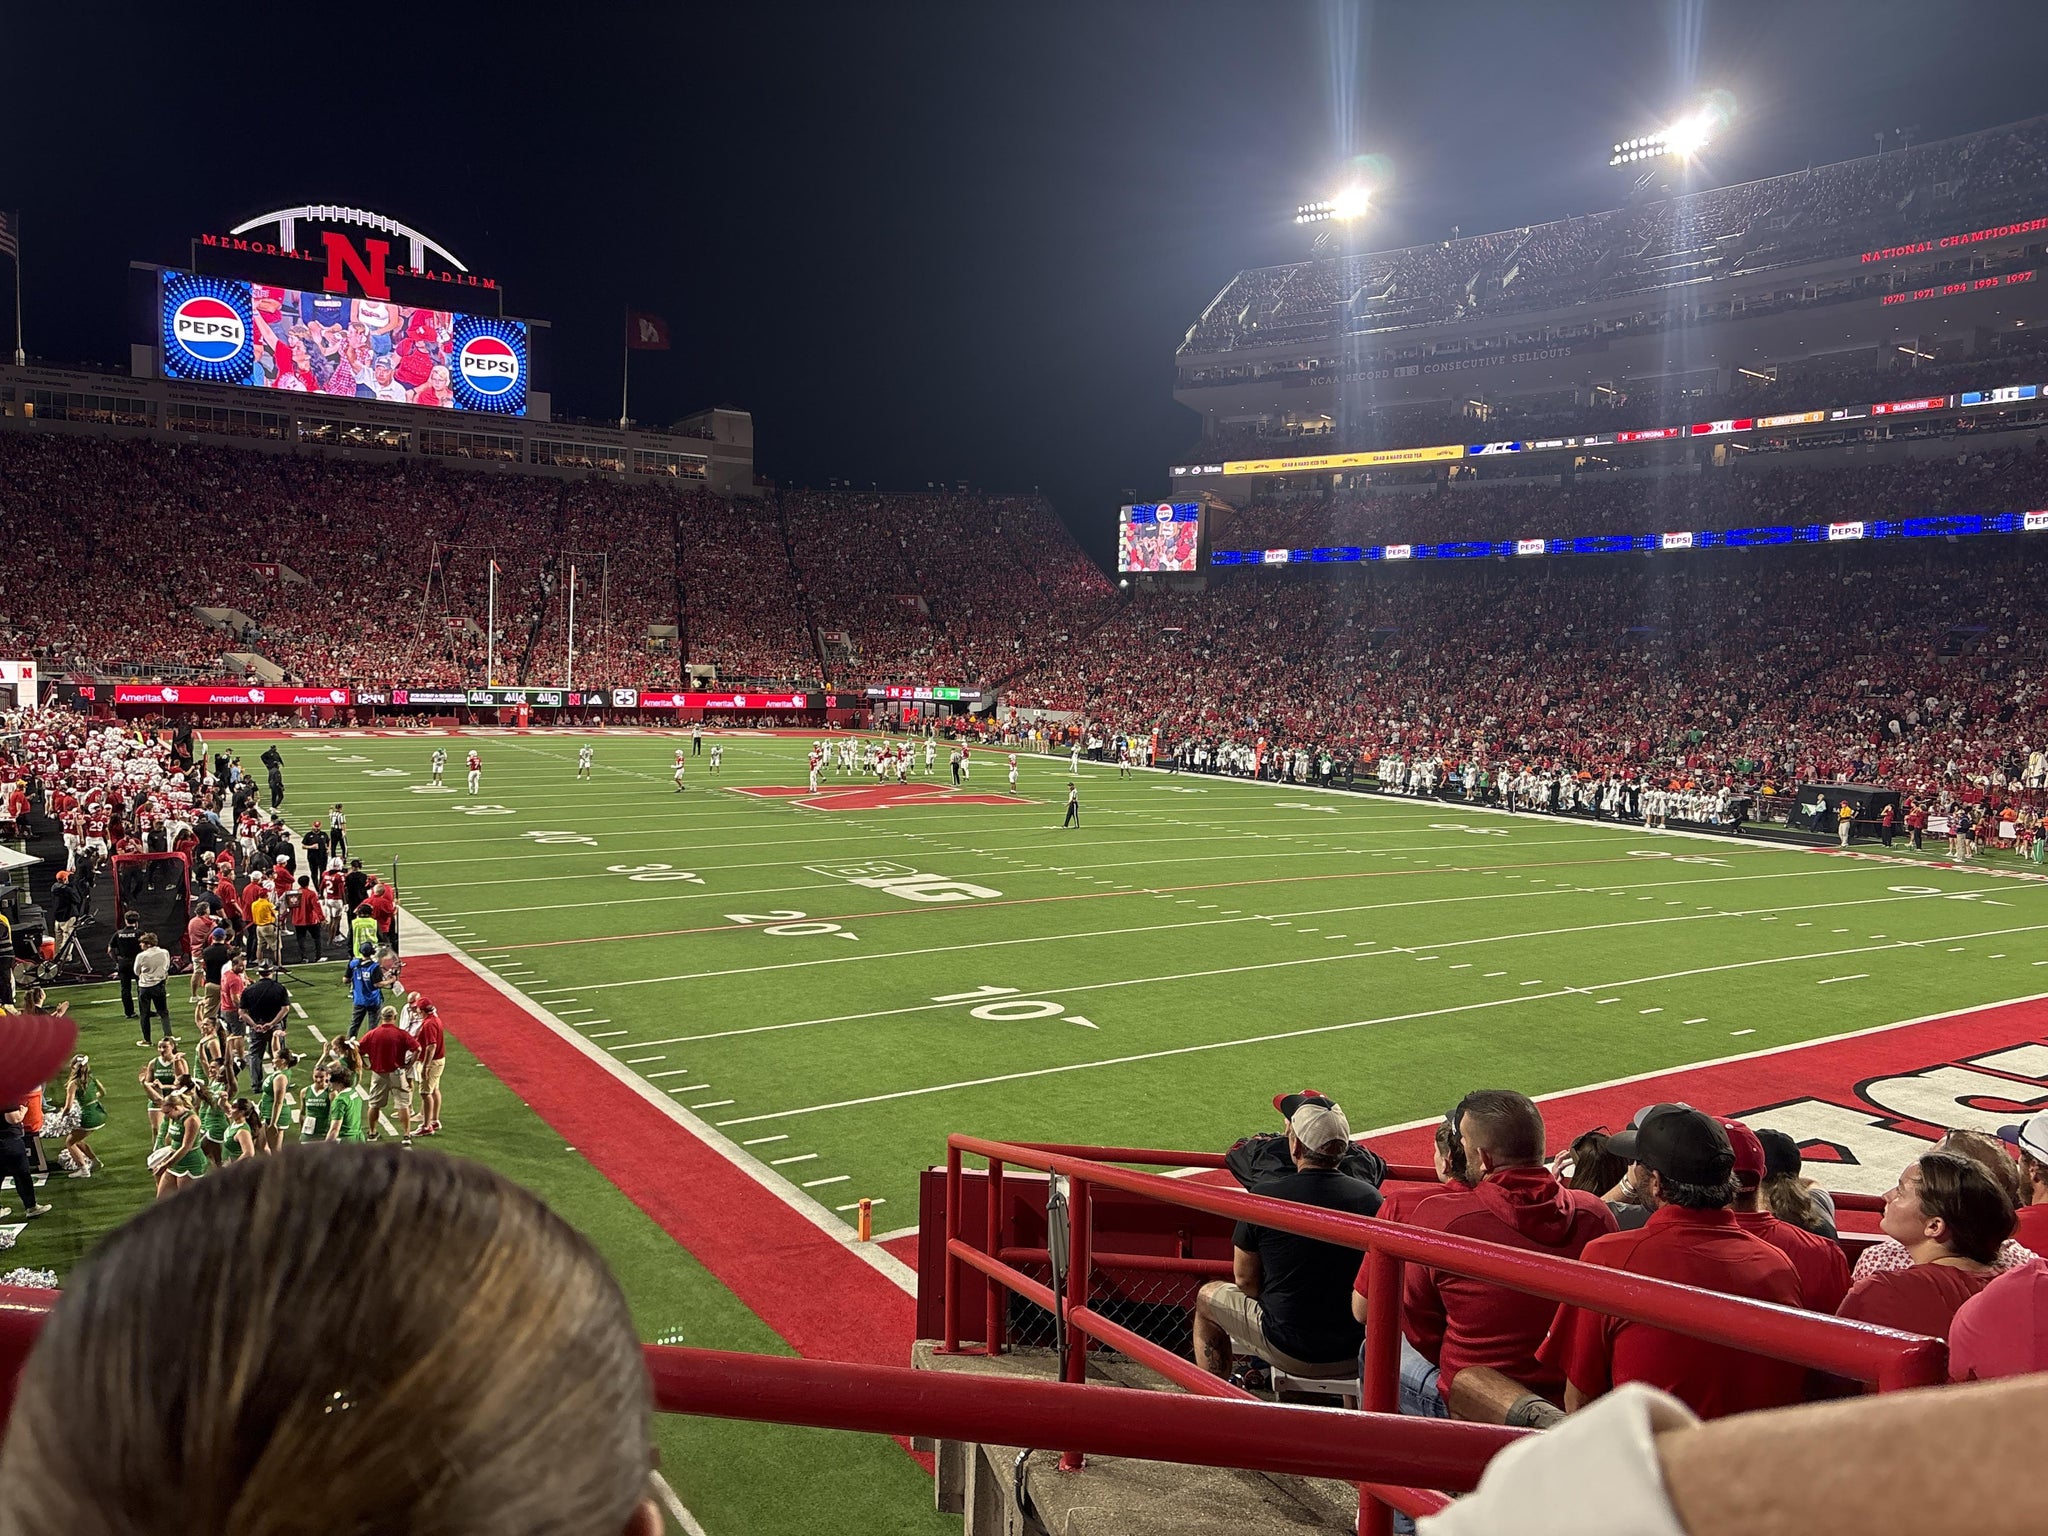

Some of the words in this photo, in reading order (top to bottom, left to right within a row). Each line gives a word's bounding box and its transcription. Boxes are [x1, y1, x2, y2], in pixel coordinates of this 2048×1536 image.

[202, 233, 313, 261] MEMORIAL
[1861, 241, 1933, 263] NATIONAL
[322, 231, 390, 300] N
[397, 264, 497, 289] STADIUM
[1882, 294, 1905, 305] 1970
[1913, 289, 1935, 300] 1971
[1942, 283, 1967, 295] 1994
[1973, 278, 1999, 290] 1995
[2005, 272, 2033, 284] 1997
[178, 318, 241, 340] PEPSI
[464, 357, 515, 375] PEPSI
[1310, 376, 1340, 386] NCAA
[1346, 370, 1389, 383] RECORD
[1424, 355, 1506, 374] CONSECUTIVE
[1511, 347, 1572, 363] SELLOUTS
[1642, 431, 1665, 439] VIRGINIA
[1482, 442, 1513, 454] ACC
[1831, 526, 1862, 538] PEPSI
[1665, 535, 1691, 546] PEPSI
[1520, 543, 1544, 552] PEPSI
[22, 668, 32, 678] N
[79, 687, 95, 700] N
[120, 693, 161, 702] Ameritas
[357, 694, 385, 703] 12:44
[393, 690, 408, 704] N
[471, 692, 493, 702] Allo
[537, 692, 558, 702] Allo
[616, 692, 633, 704] 25
[891, 688, 899, 697] N
[902, 689, 912, 697] 24
[209, 695, 249, 703] Ameritas
[293, 695, 330, 704] Ameritas
[569, 694, 580, 705] N
[643, 699, 672, 707] Ameritas
[706, 699, 734, 707] Ameritas
[766, 700, 792, 708] Ameritas
[89, 821, 104, 831] 29
[520, 830, 594, 844] 40
[606, 863, 697, 881] 30
[326, 881, 334, 894] 2
[723, 910, 842, 936] 20
[930, 985, 1065, 1021] 10
